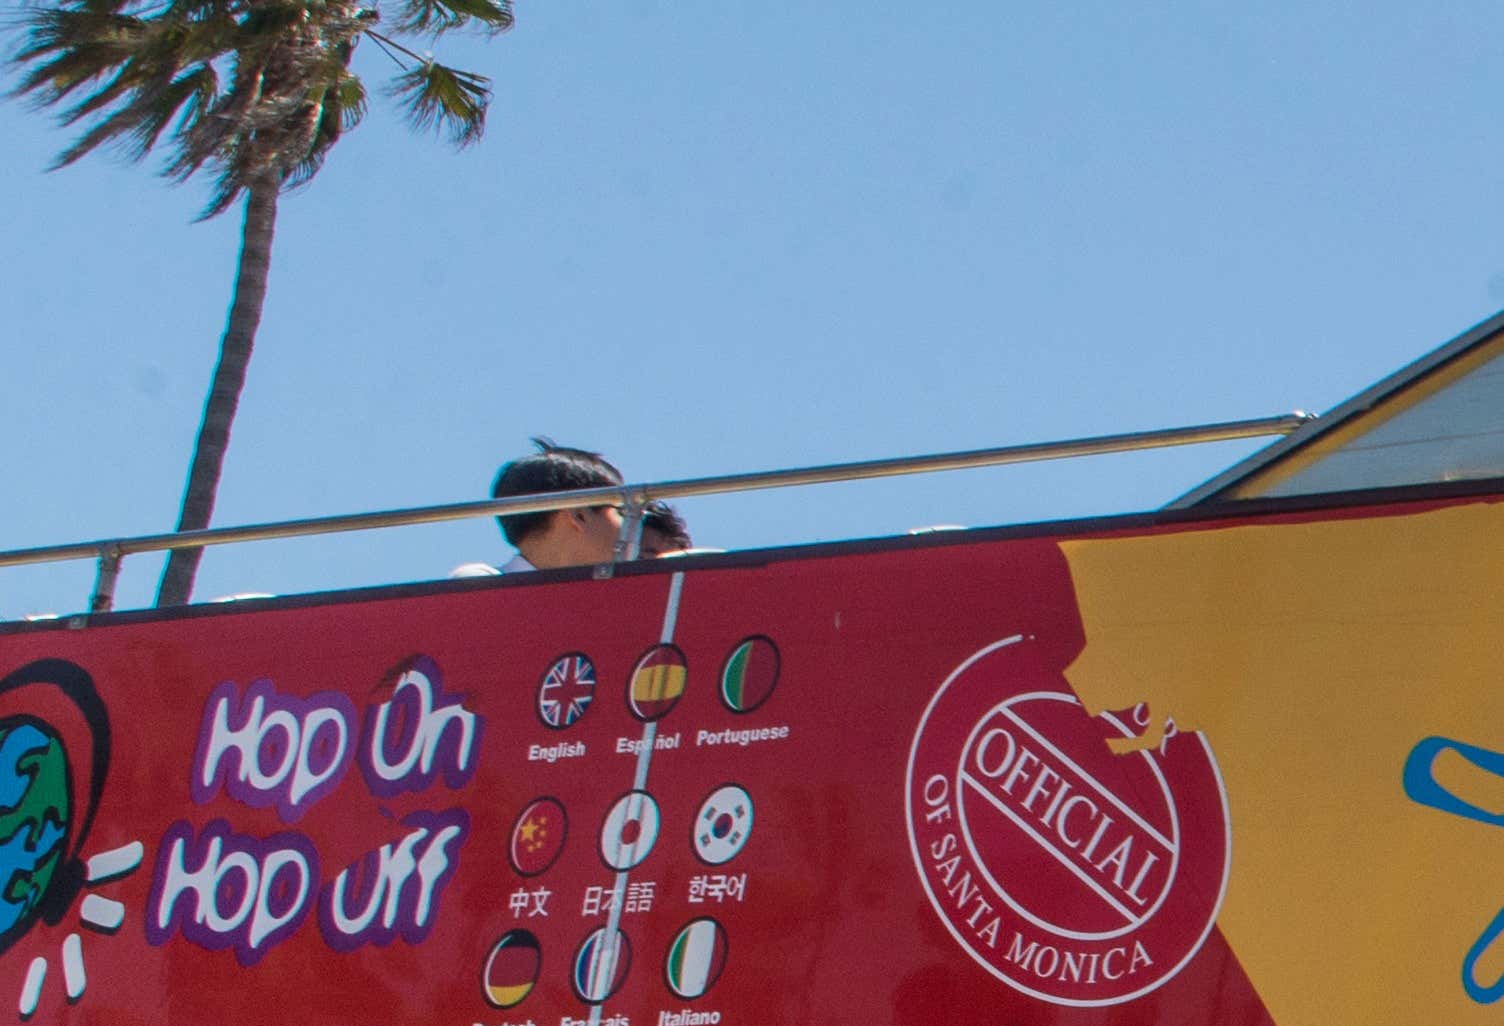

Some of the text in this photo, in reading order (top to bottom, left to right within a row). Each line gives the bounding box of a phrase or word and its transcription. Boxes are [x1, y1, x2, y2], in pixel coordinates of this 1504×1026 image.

[203, 694, 348, 806] Hop
[528, 741, 586, 763] English
[616, 733, 681, 755] Espñol
[696, 726, 790, 747] Portuguese
[975, 728, 1160, 907] OFFICIAL
[157, 835, 310, 949] Hop
[687, 873, 748, 903] 한국어
[924, 773, 1156, 985] OF SANTA MONICA
[508, 885, 552, 918] 中文
